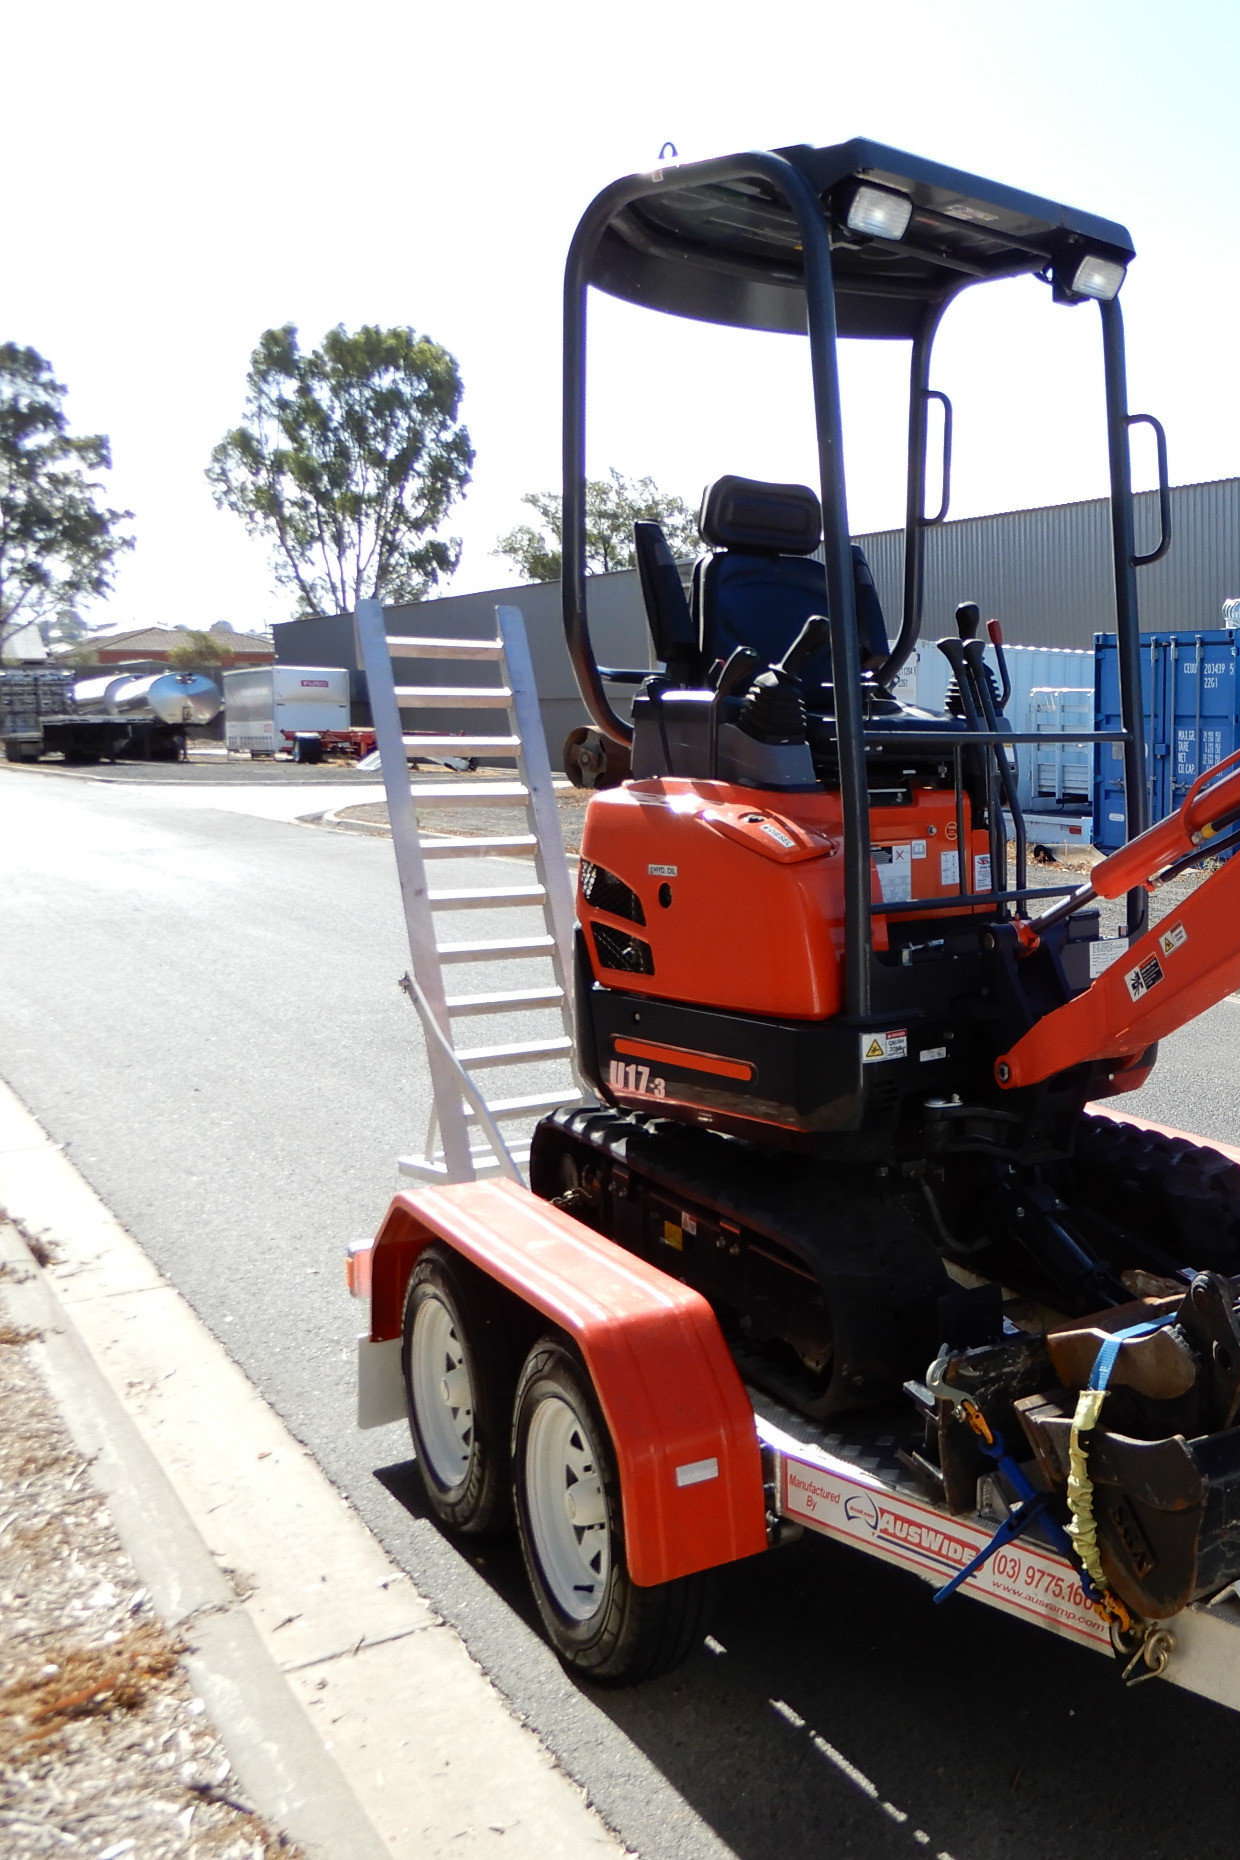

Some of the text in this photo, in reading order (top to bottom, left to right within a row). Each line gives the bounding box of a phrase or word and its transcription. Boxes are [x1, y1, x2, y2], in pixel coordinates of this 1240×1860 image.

[1204, 663, 1226, 674] 203439
[1229, 663, 1234, 676] 5
[1204, 678, 1218, 688] 22G1
[1178, 741, 1190, 752] TARE
[1178, 752, 1186, 762] NET
[769, 829, 792, 846] DIESEL
[609, 1060, 666, 1098] U17-3
[788, 1473, 840, 1504] Manufactured
[806, 1495, 818, 1512] By
[992, 1550, 1022, 1584] (03)
[992, 1580, 1106, 1633] www.ausramp.com
